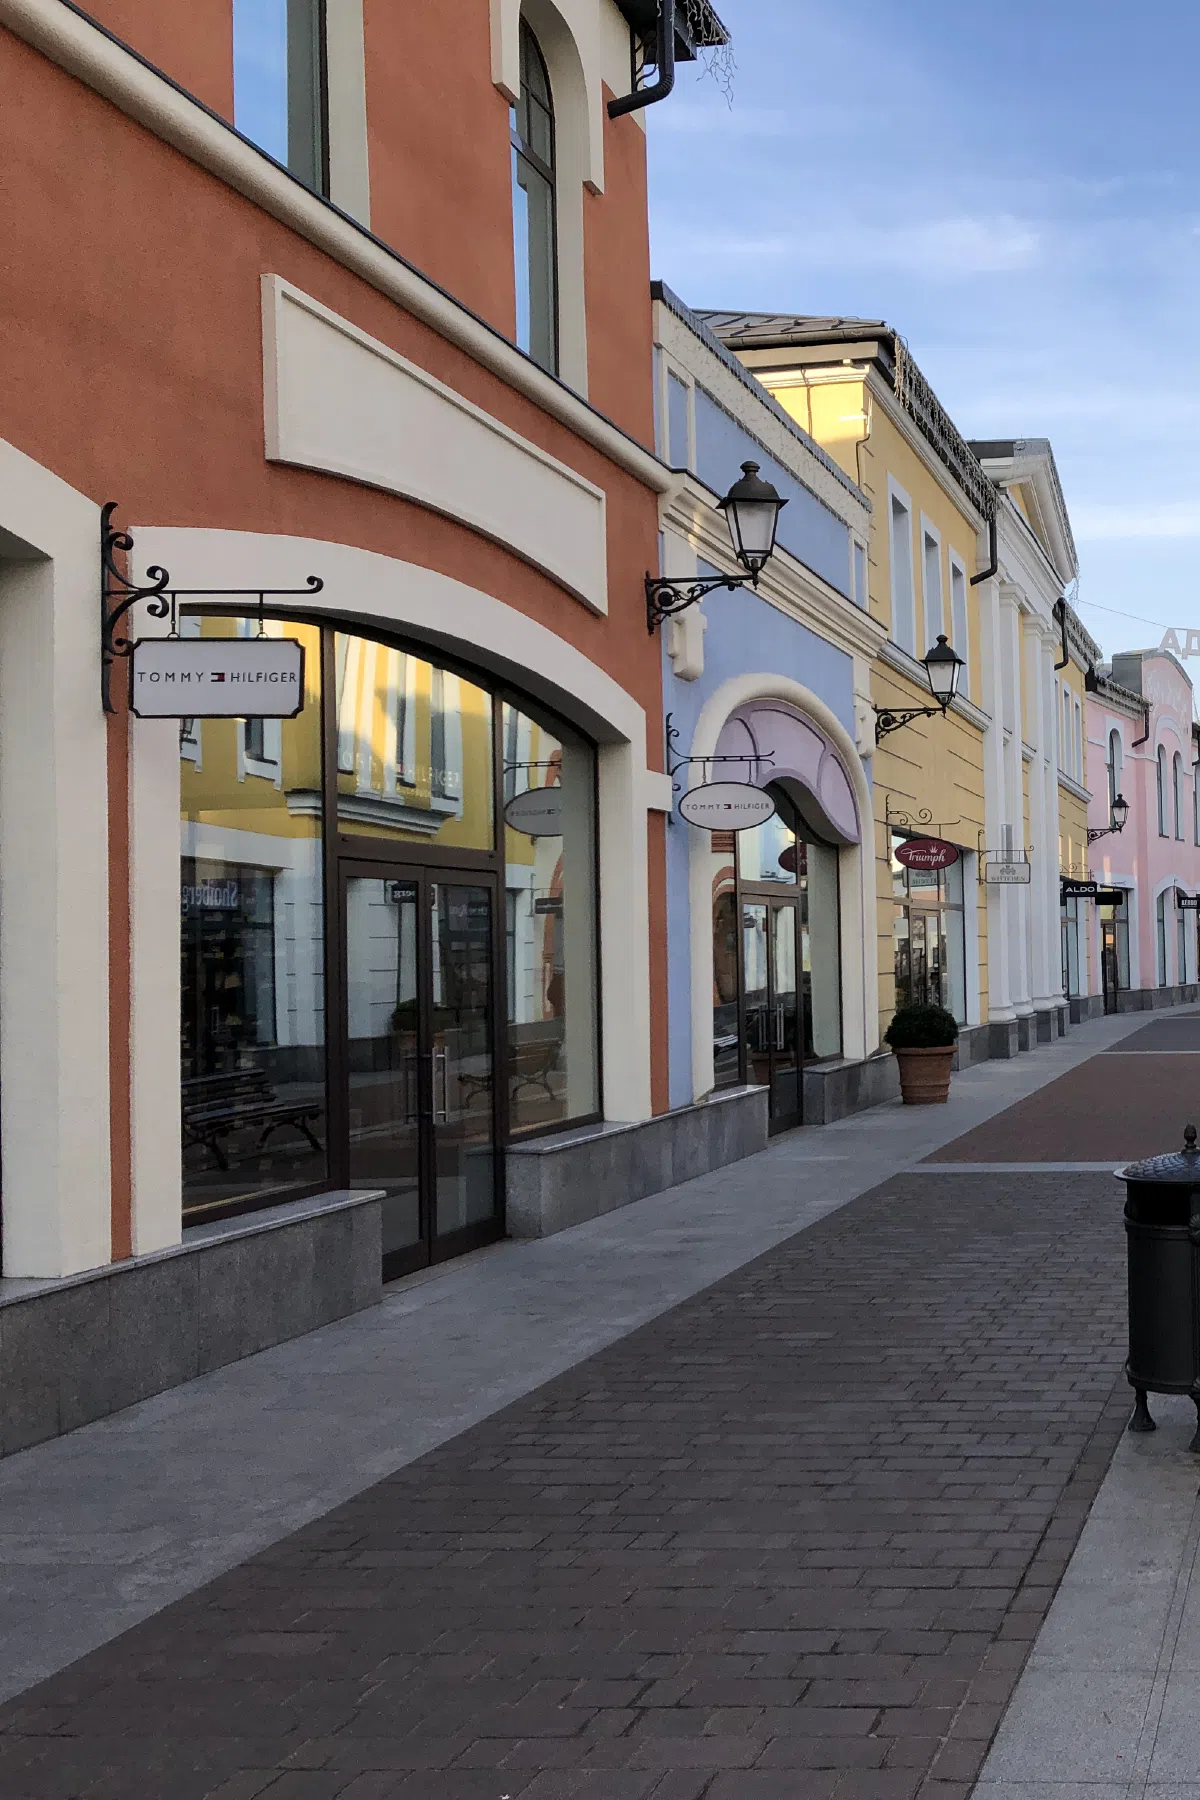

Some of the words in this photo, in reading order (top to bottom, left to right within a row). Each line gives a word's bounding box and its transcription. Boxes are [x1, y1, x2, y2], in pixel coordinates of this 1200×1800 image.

[137, 672, 204, 683] TOMMY
[230, 672, 297, 683] HILFIGER
[901, 848, 947, 867] Triumph
